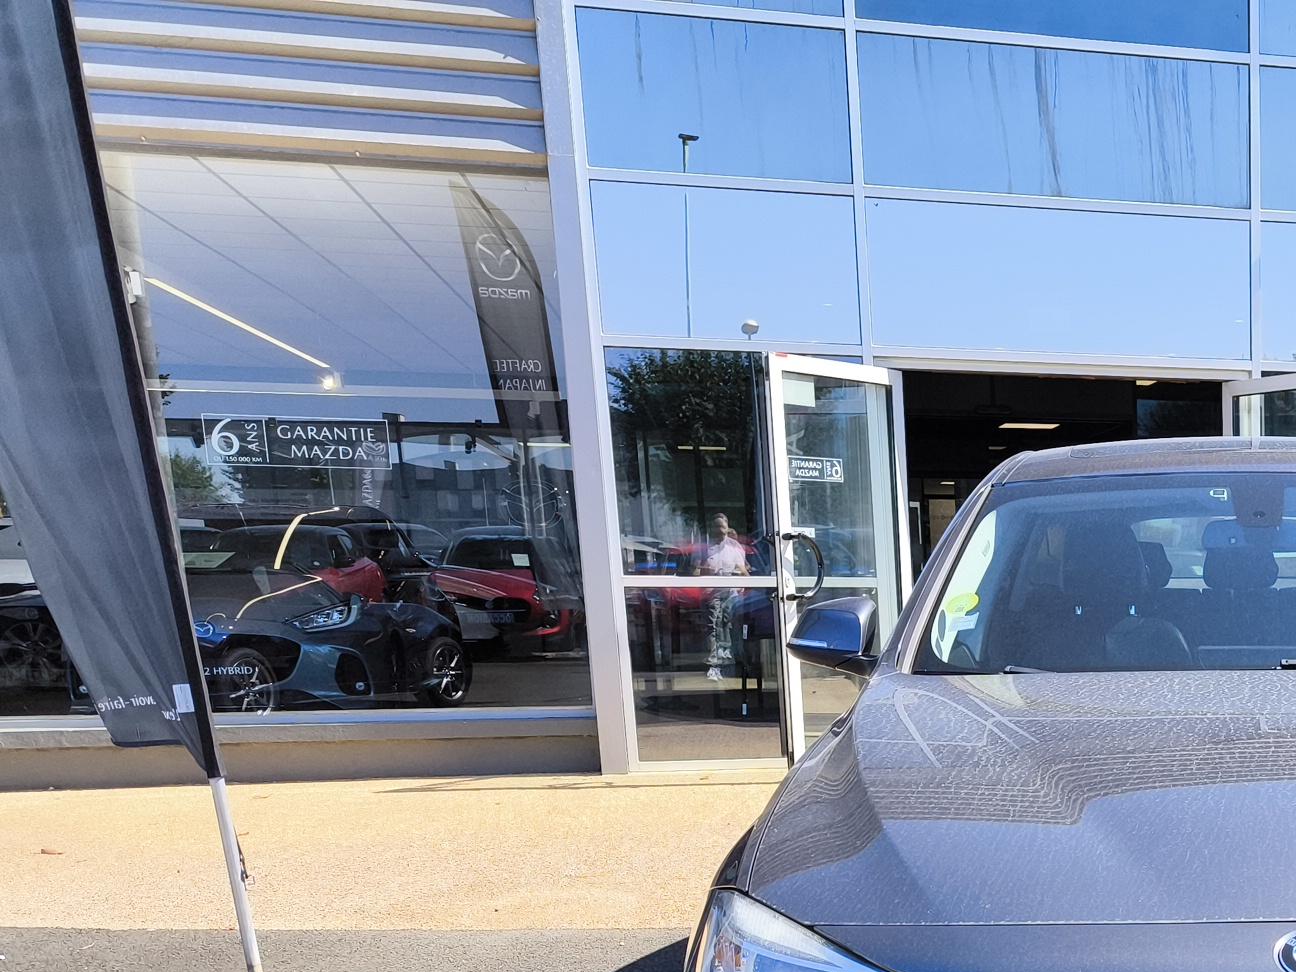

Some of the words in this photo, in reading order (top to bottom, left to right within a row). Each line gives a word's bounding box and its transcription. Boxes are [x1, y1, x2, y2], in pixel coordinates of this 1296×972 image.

[211, 418, 240, 456] 6
[245, 422, 261, 452] ANS
[276, 425, 377, 442] GARANTIE
[291, 444, 367, 460] MAZDA
[213, 666, 253, 676] HYBRID
